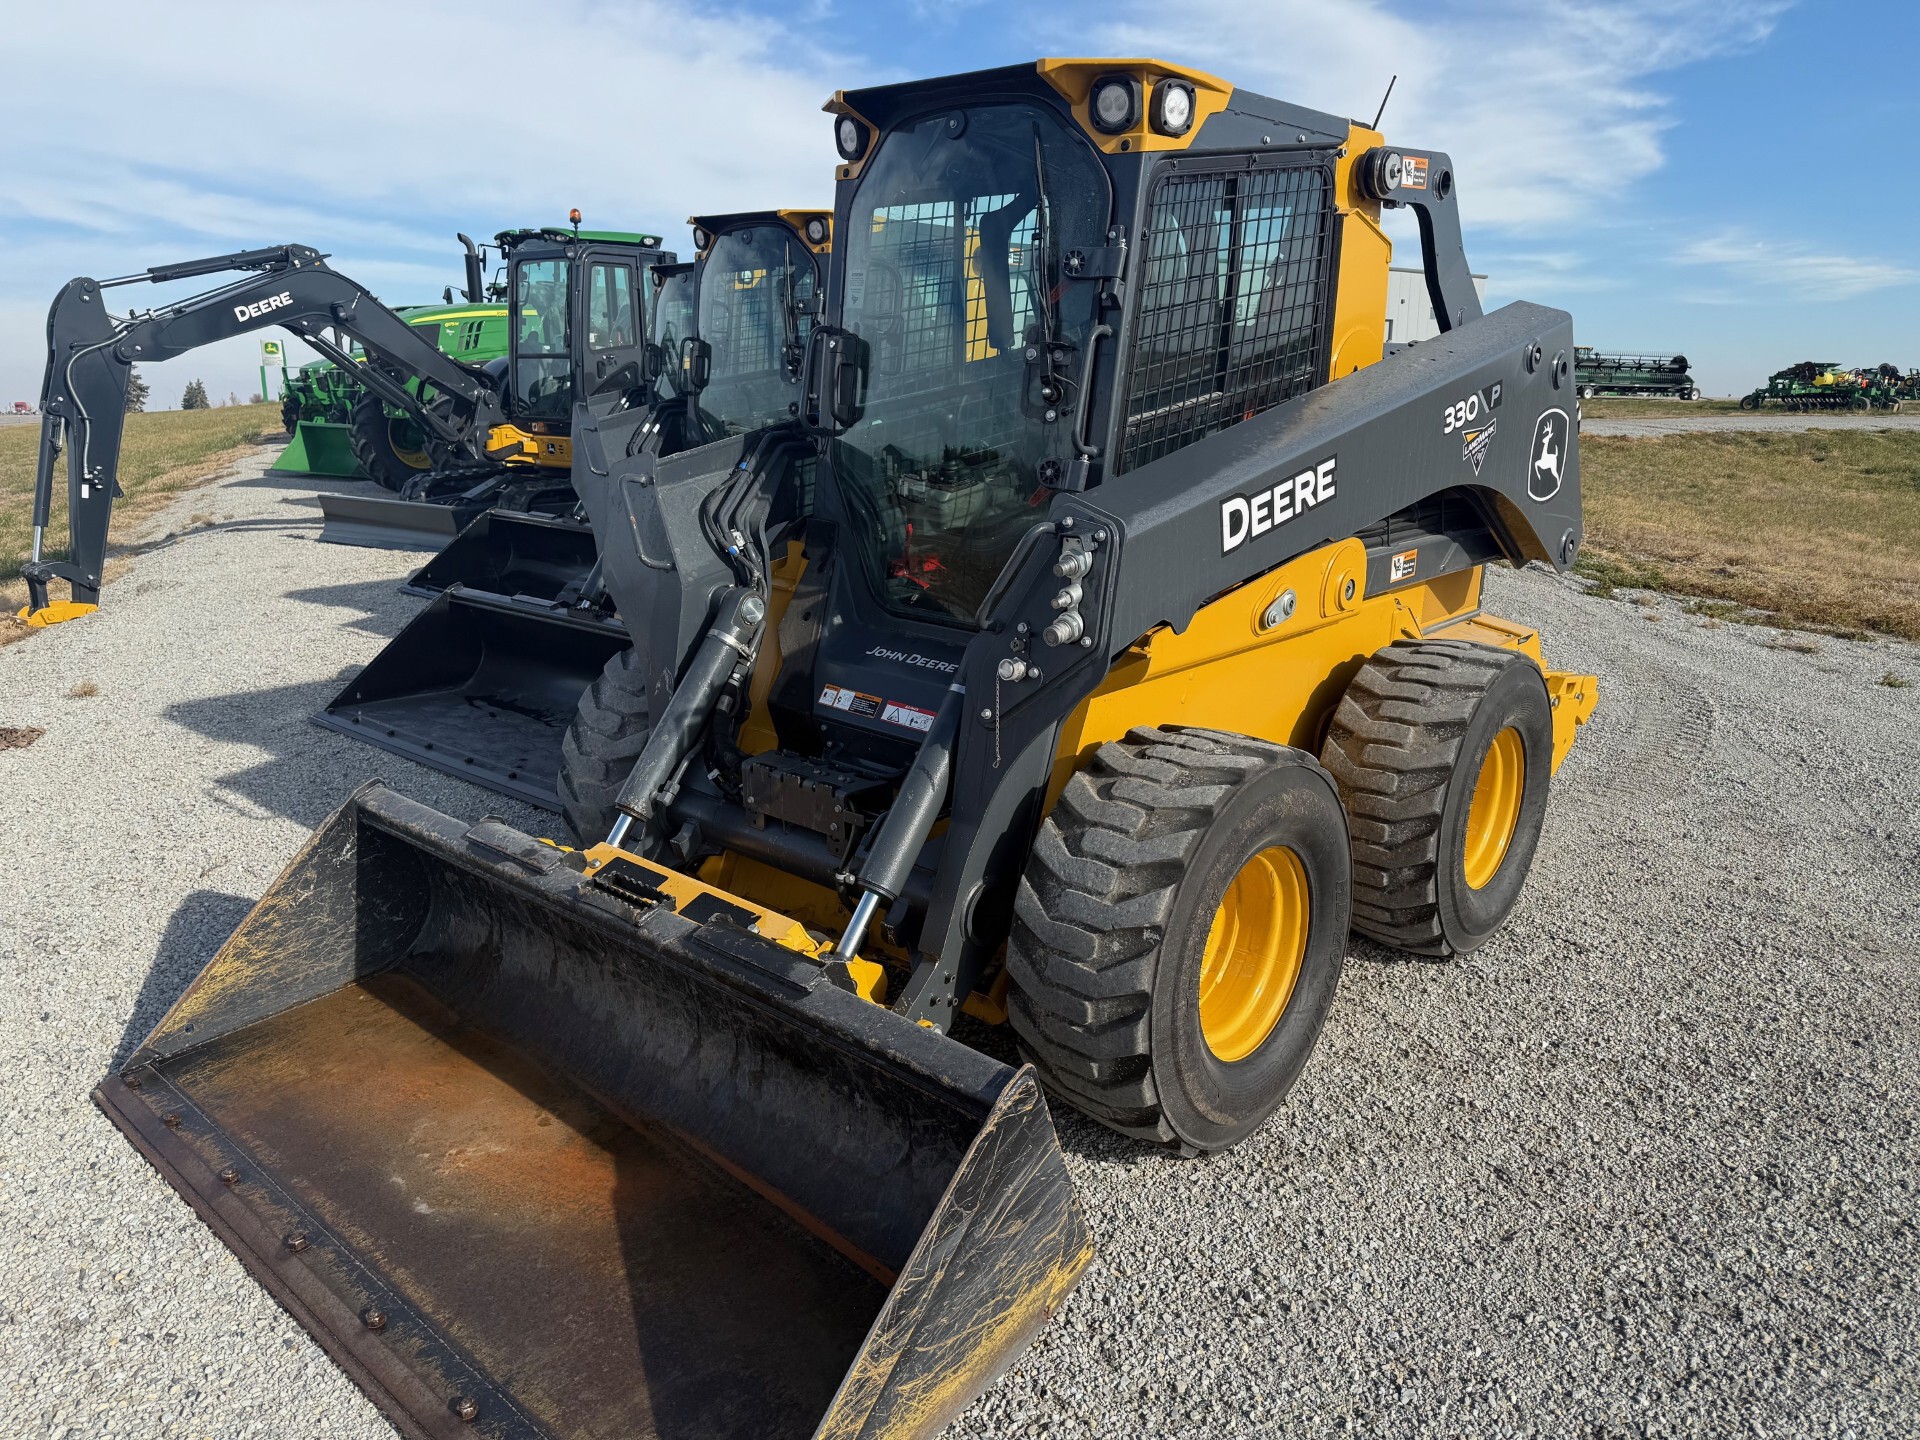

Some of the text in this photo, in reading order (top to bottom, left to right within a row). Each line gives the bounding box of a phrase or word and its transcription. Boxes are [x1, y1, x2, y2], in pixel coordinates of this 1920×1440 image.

[233, 291, 293, 322] DEERE
[1443, 384, 1501, 434] 330 P
[1464, 424, 1495, 456] LANDMARK
[1222, 458, 1336, 553] DEERE
[865, 646, 959, 673] JOHN DEERE
